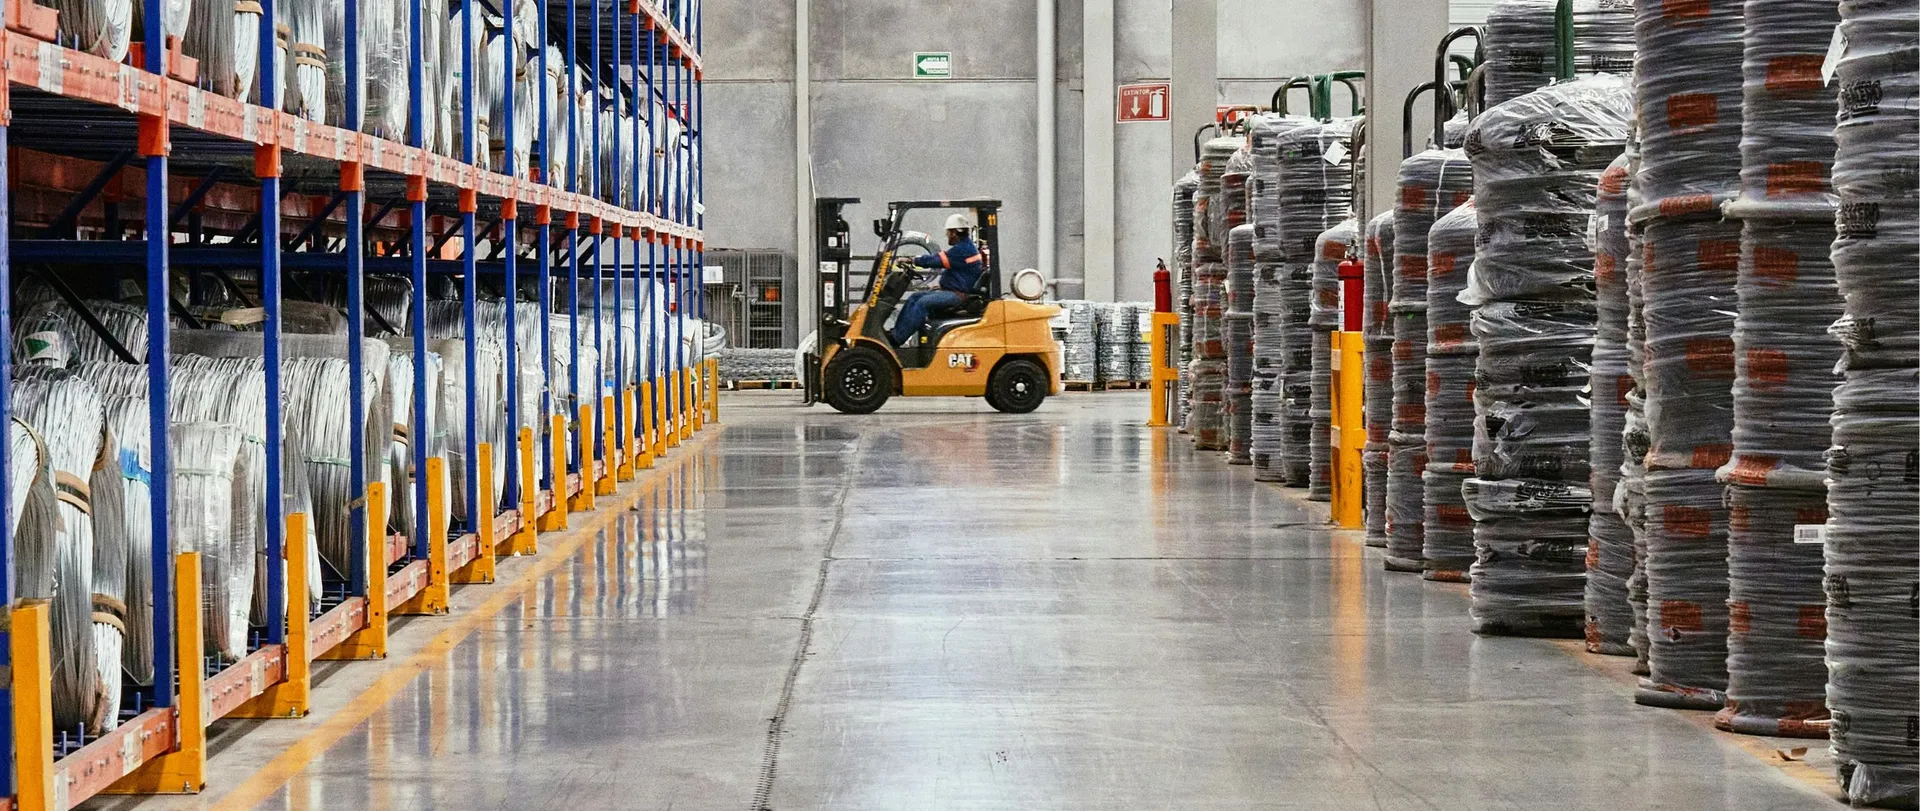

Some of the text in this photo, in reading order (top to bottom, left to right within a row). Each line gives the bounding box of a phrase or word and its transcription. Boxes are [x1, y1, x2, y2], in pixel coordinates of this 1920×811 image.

[1123, 88, 1150, 96] EXTINTOR
[987, 213, 996, 226] 11
[947, 353, 973, 368] CAT
